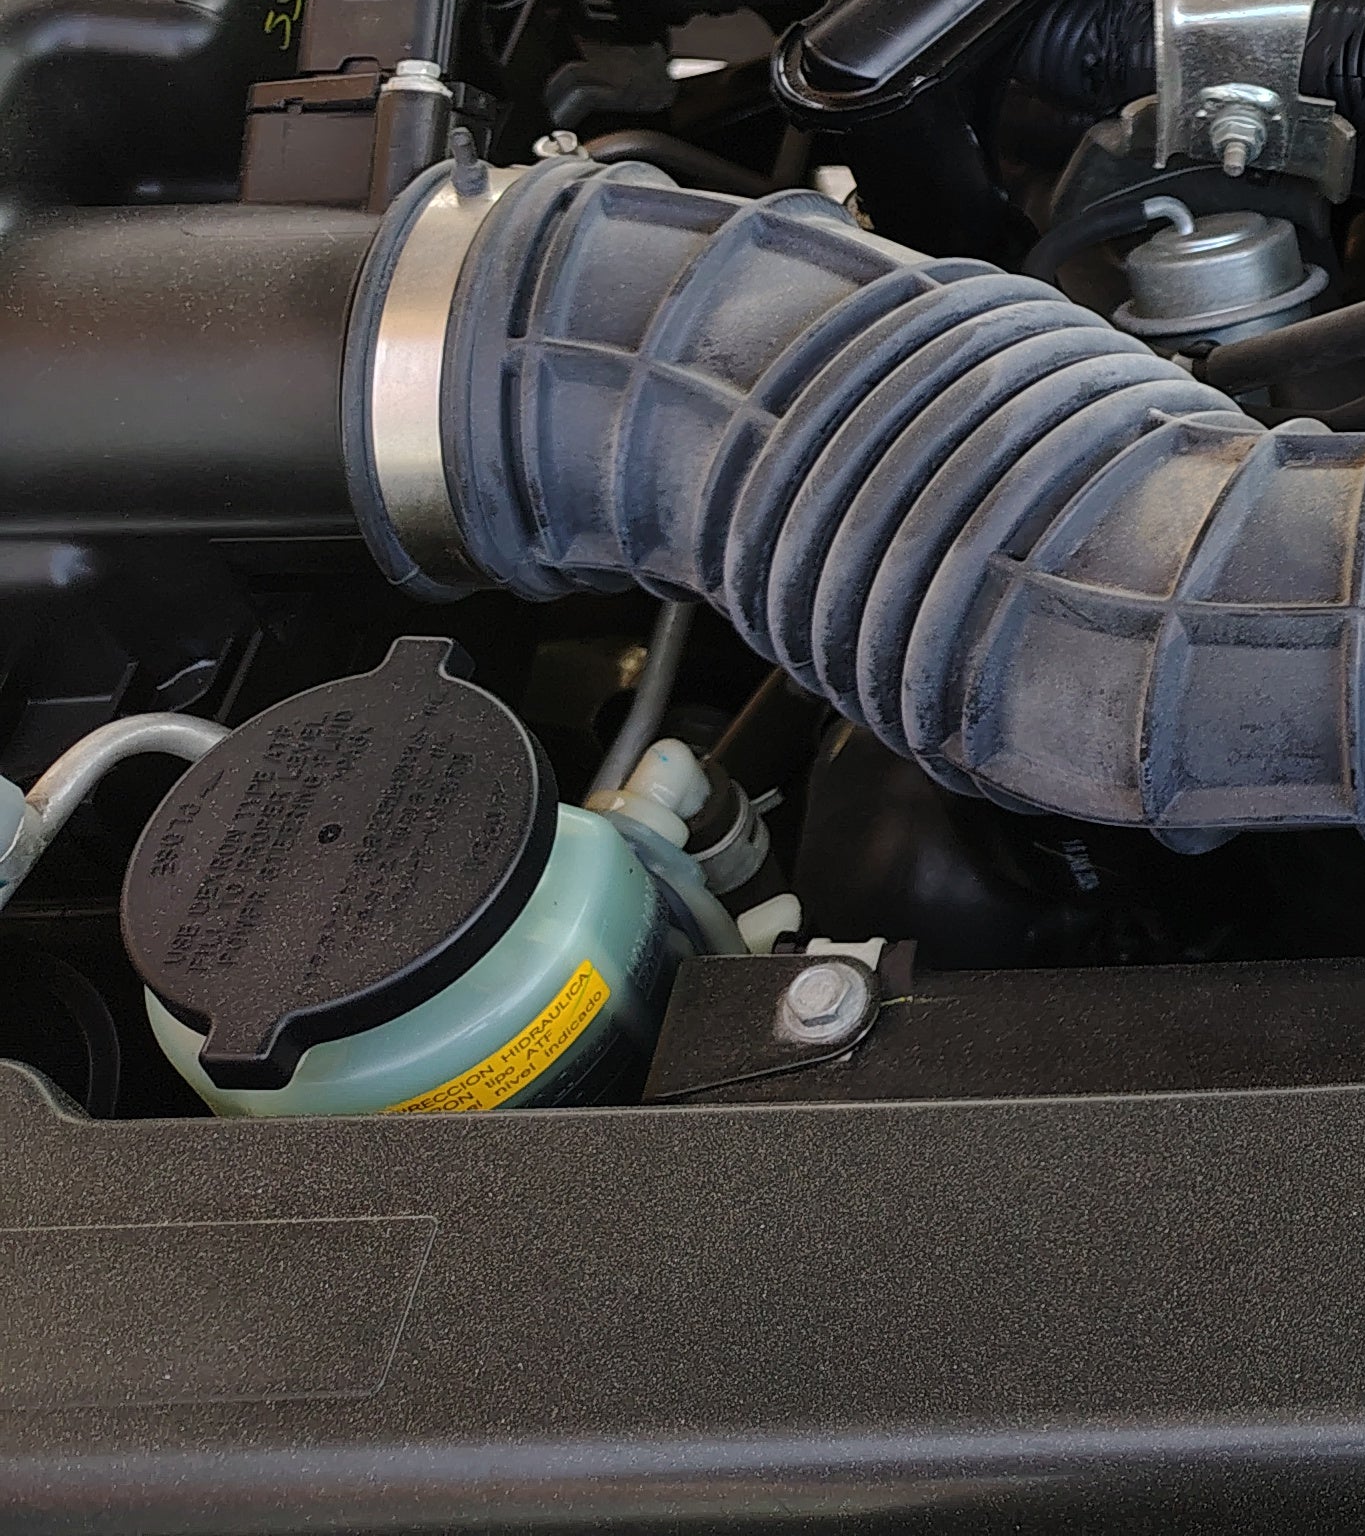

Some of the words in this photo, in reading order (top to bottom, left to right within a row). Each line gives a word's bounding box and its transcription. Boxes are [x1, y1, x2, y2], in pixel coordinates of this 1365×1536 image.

[163, 921, 201, 965] USE
[188, 827, 248, 916] DEXRON
[232, 769, 276, 823] TYPE
[187, 927, 222, 971] FILL
[401, 1064, 495, 1113] RECCION
[501, 972, 590, 1064] HIDRAULICA
[484, 1066, 515, 1089] tipo
[526, 1030, 553, 1061] ATF
[494, 1062, 537, 1097] nivel
[544, 990, 603, 1058] indicado
